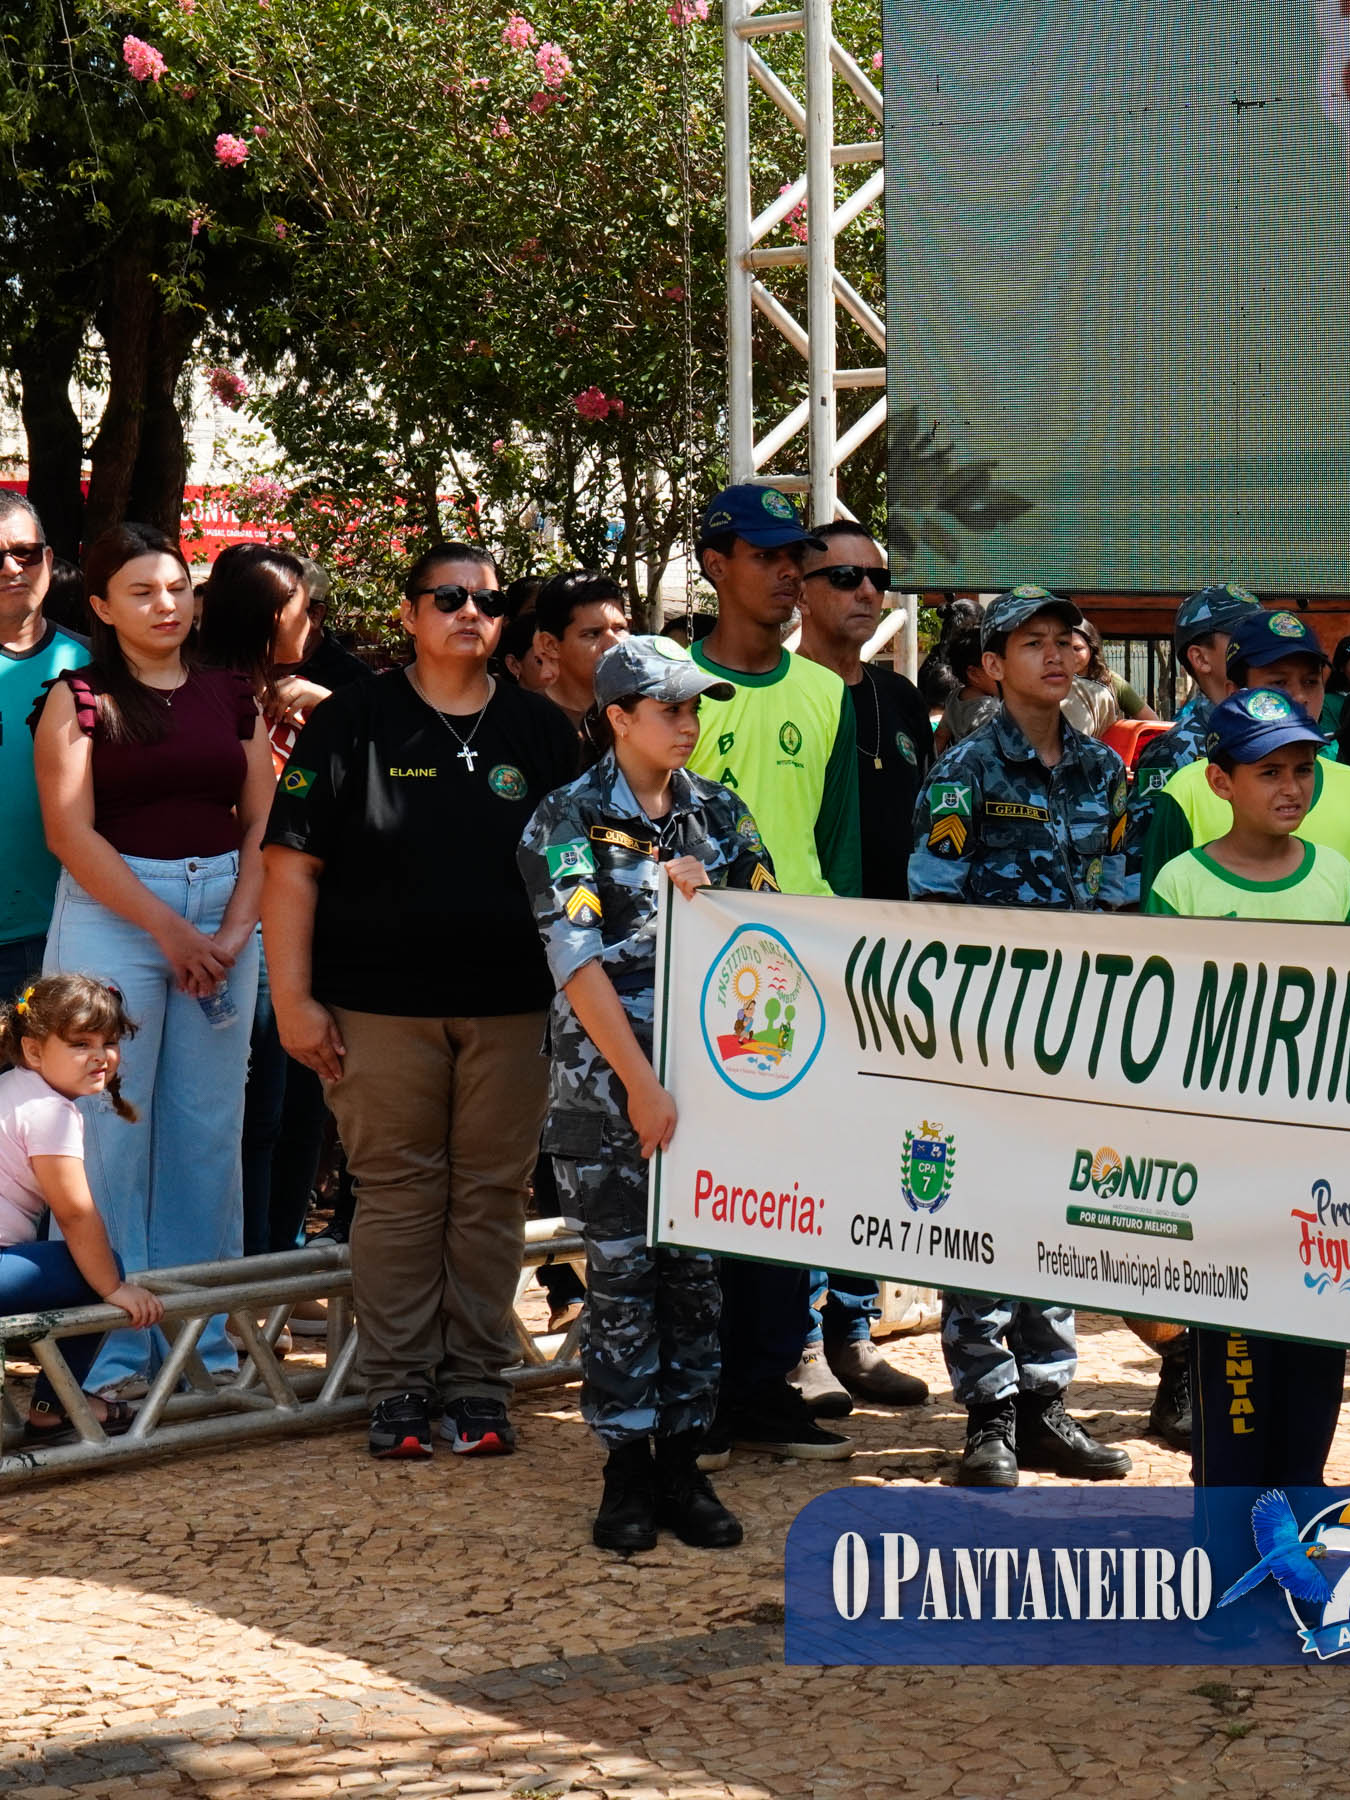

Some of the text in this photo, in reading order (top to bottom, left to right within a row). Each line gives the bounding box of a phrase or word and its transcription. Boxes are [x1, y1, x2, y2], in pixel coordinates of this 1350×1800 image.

[390, 768, 437, 777] ELAINE
[995, 805, 1040, 818] GELLER
[717, 945, 762, 1008] INSTITUTO
[845, 935, 1175, 1084] INSTITUTO
[918, 1162, 937, 1175] CPA
[922, 1176, 931, 1192] 7
[1069, 1146, 1198, 1206] BONITO
[694, 1169, 826, 1236] Parceria:
[1080, 1212, 1178, 1235] POR UM FUTURO MELHOR
[850, 1214, 893, 1250] CPA
[900, 1221, 911, 1251] 7
[929, 1225, 995, 1265] PMMS
[1036, 1241, 1250, 1302] Prefeitura Municipal de Bonito/MS
